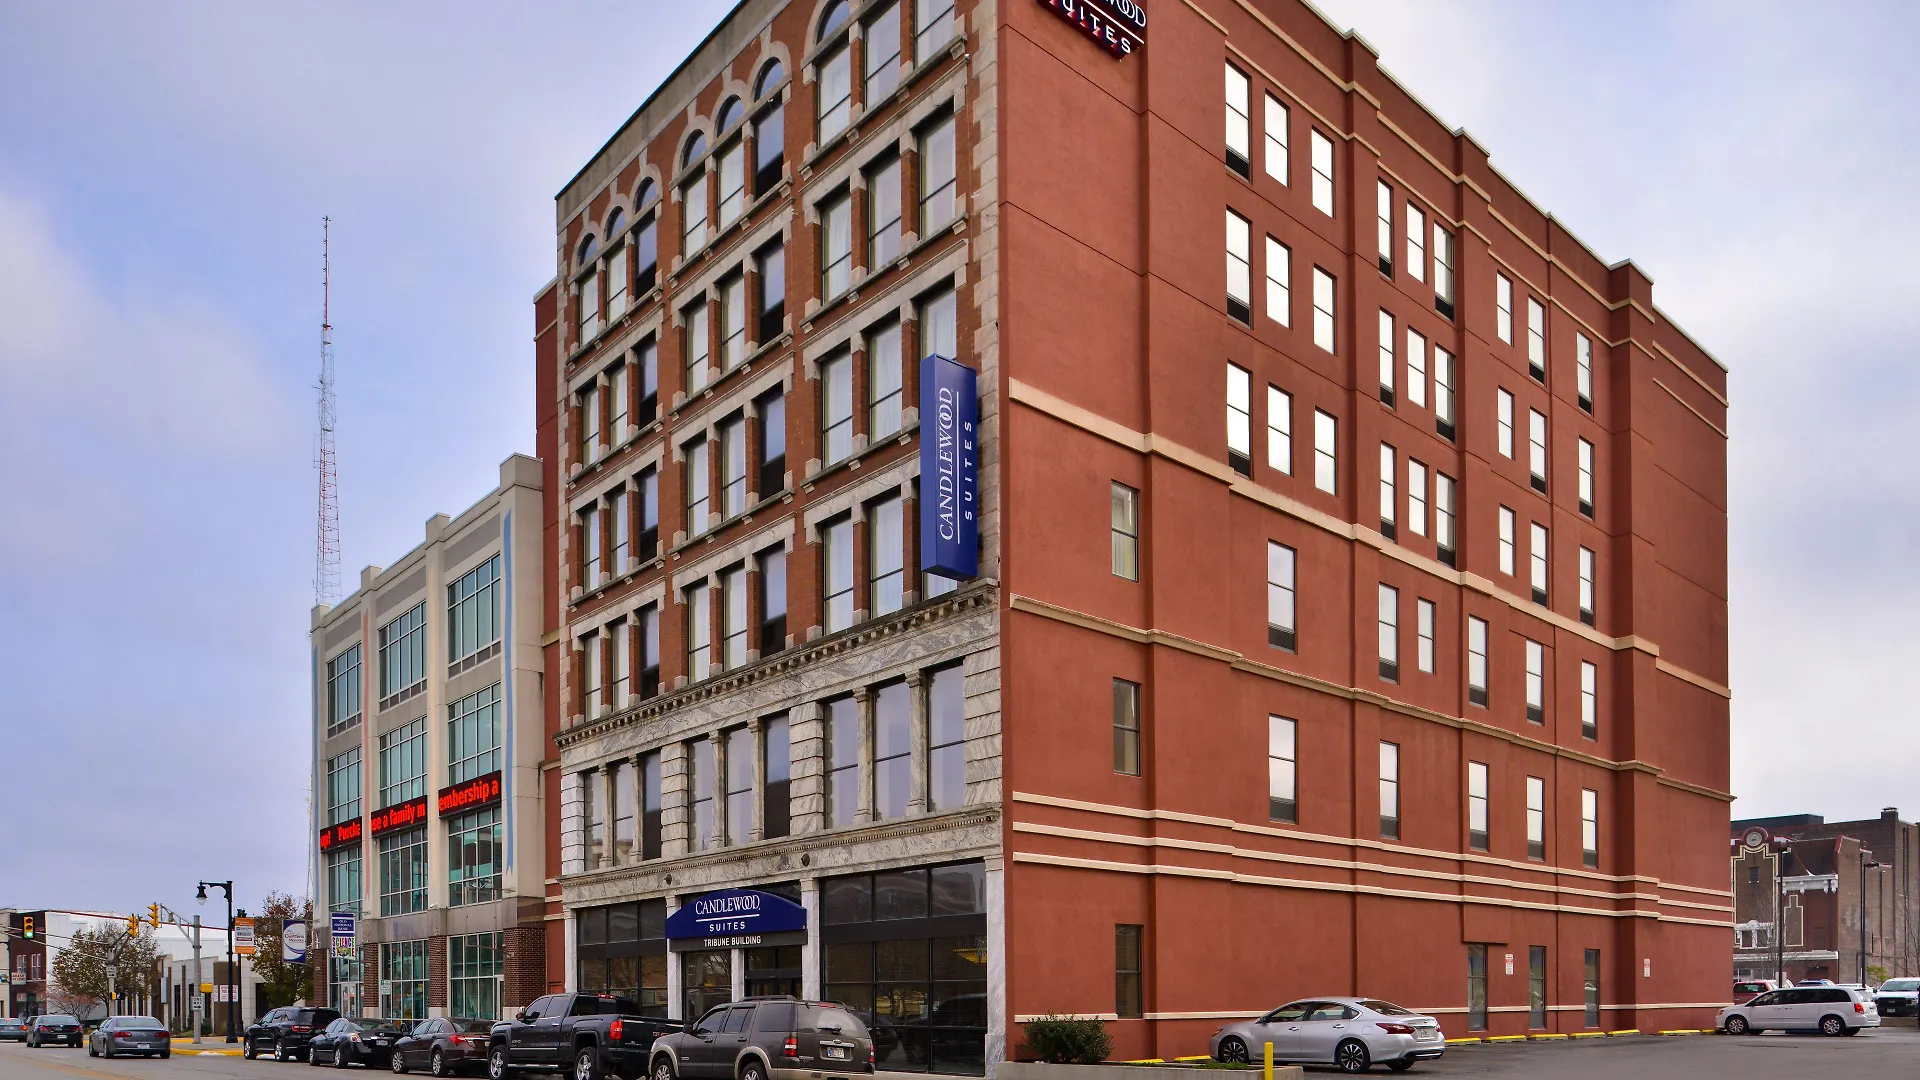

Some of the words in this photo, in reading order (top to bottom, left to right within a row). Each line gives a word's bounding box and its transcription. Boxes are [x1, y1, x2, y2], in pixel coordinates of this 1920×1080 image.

[1062, 0, 1131, 54] UITES
[938, 387, 954, 541] CANDLEWOOD
[964, 421, 973, 520] SUITES
[383, 814, 389, 828] a
[389, 803, 415, 824] family
[695, 894, 761, 914] CANDLEWOOD
[709, 921, 746, 931] SUITES
[332, 936, 355, 948] SCIENCE
[703, 937, 730, 947] TRIBUNE
[731, 935, 762, 945] BUILDING
